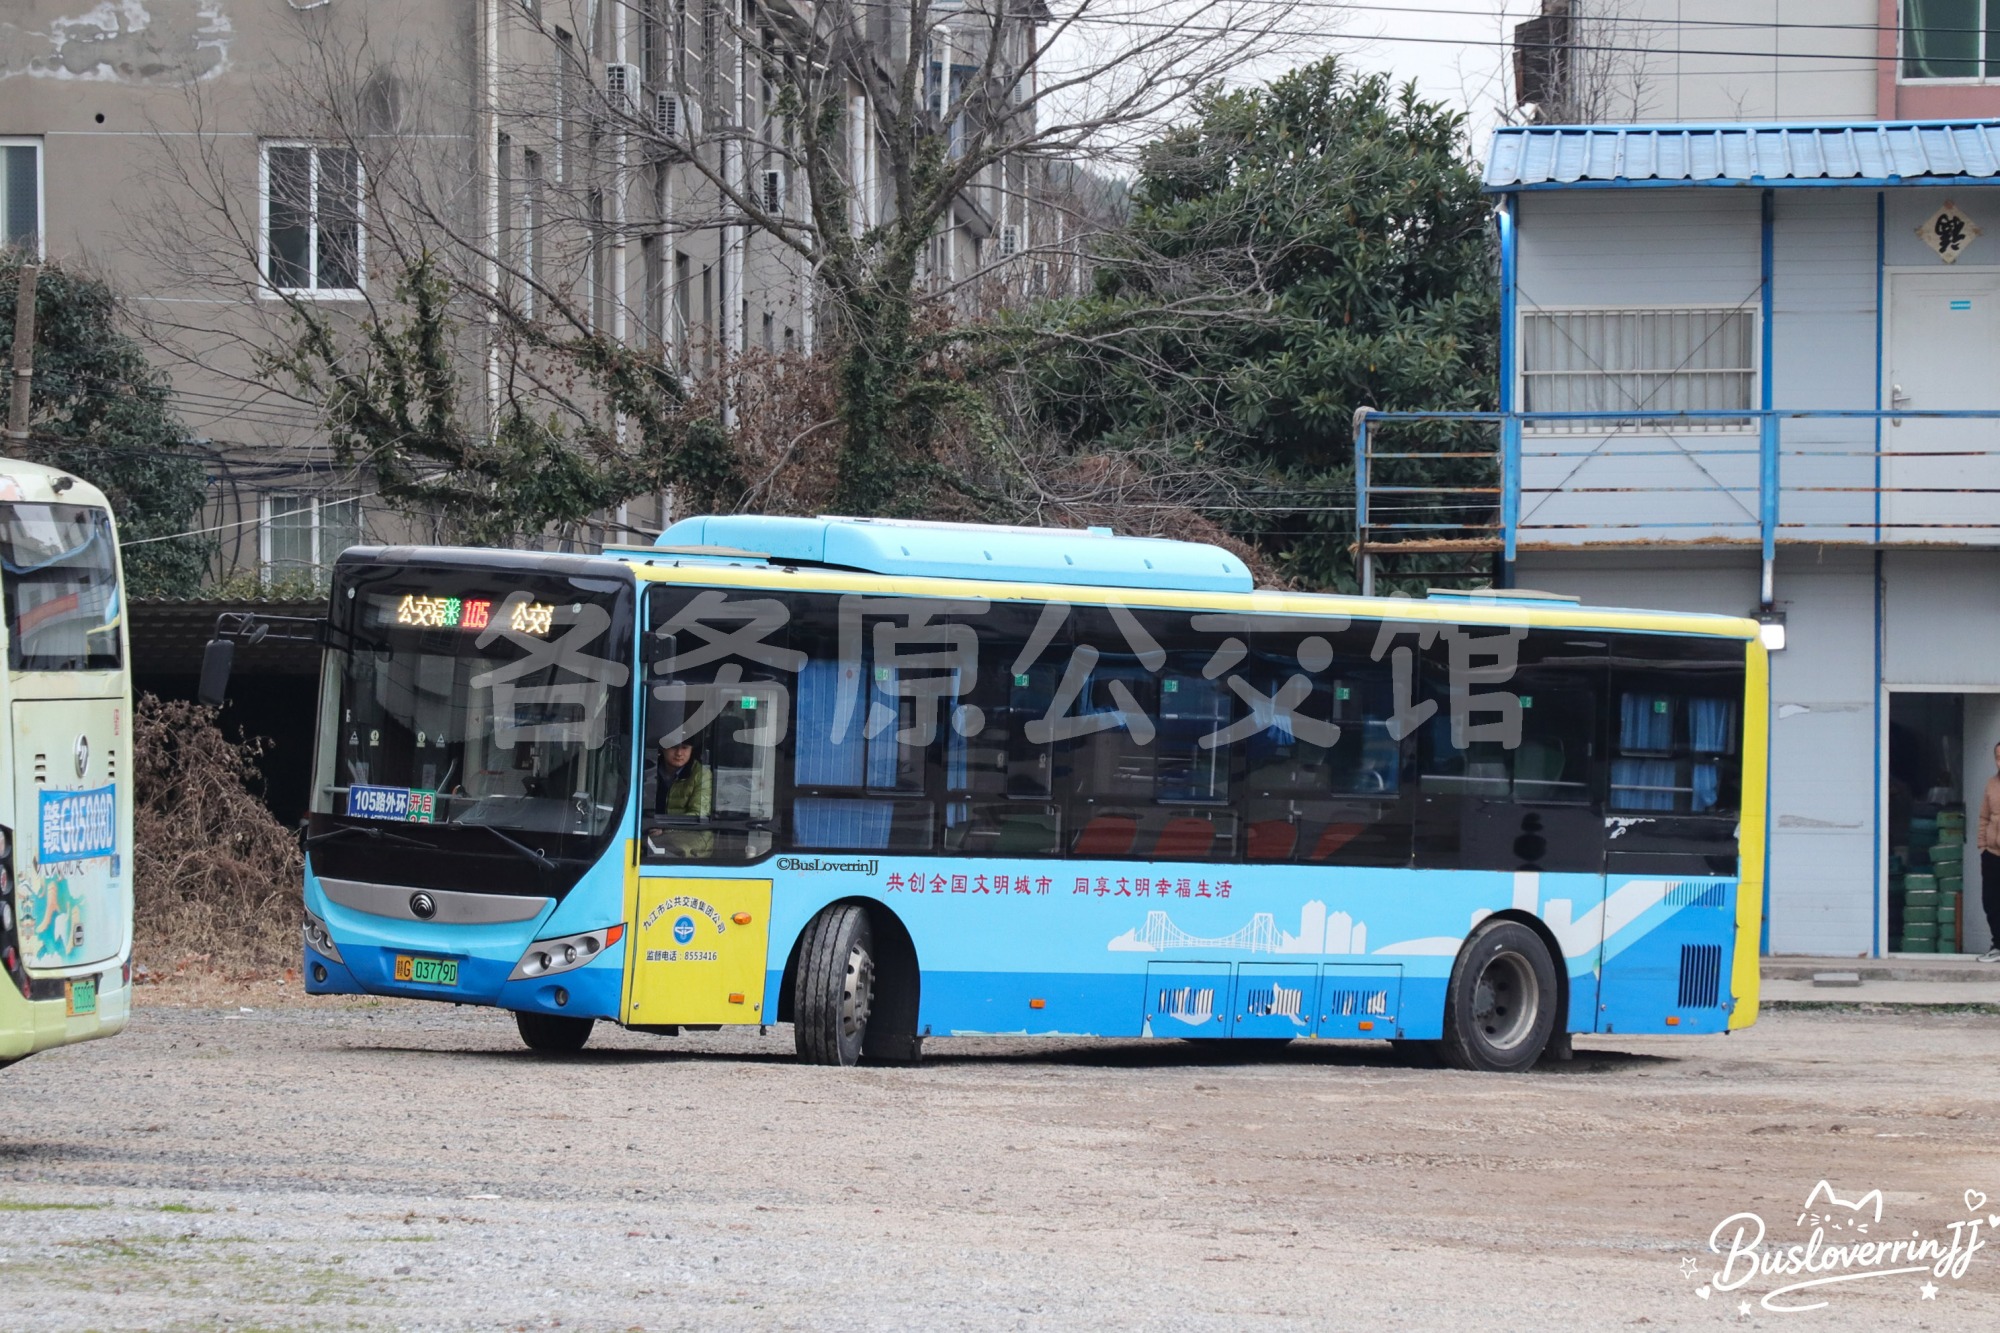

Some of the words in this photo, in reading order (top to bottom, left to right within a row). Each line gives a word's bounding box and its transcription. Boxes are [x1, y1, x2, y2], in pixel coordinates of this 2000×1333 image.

[462, 599, 491, 628] 105
[355, 790, 407, 814] 105路外环
[410, 793, 433, 814] 开启
[43, 793, 114, 855] 赣G05008D
[886, 872, 1053, 896] 共创全国文明城市
[1072, 876, 1233, 899] 同享文明幸福生活
[642, 896, 726, 934] 九江市公共交通集团公司
